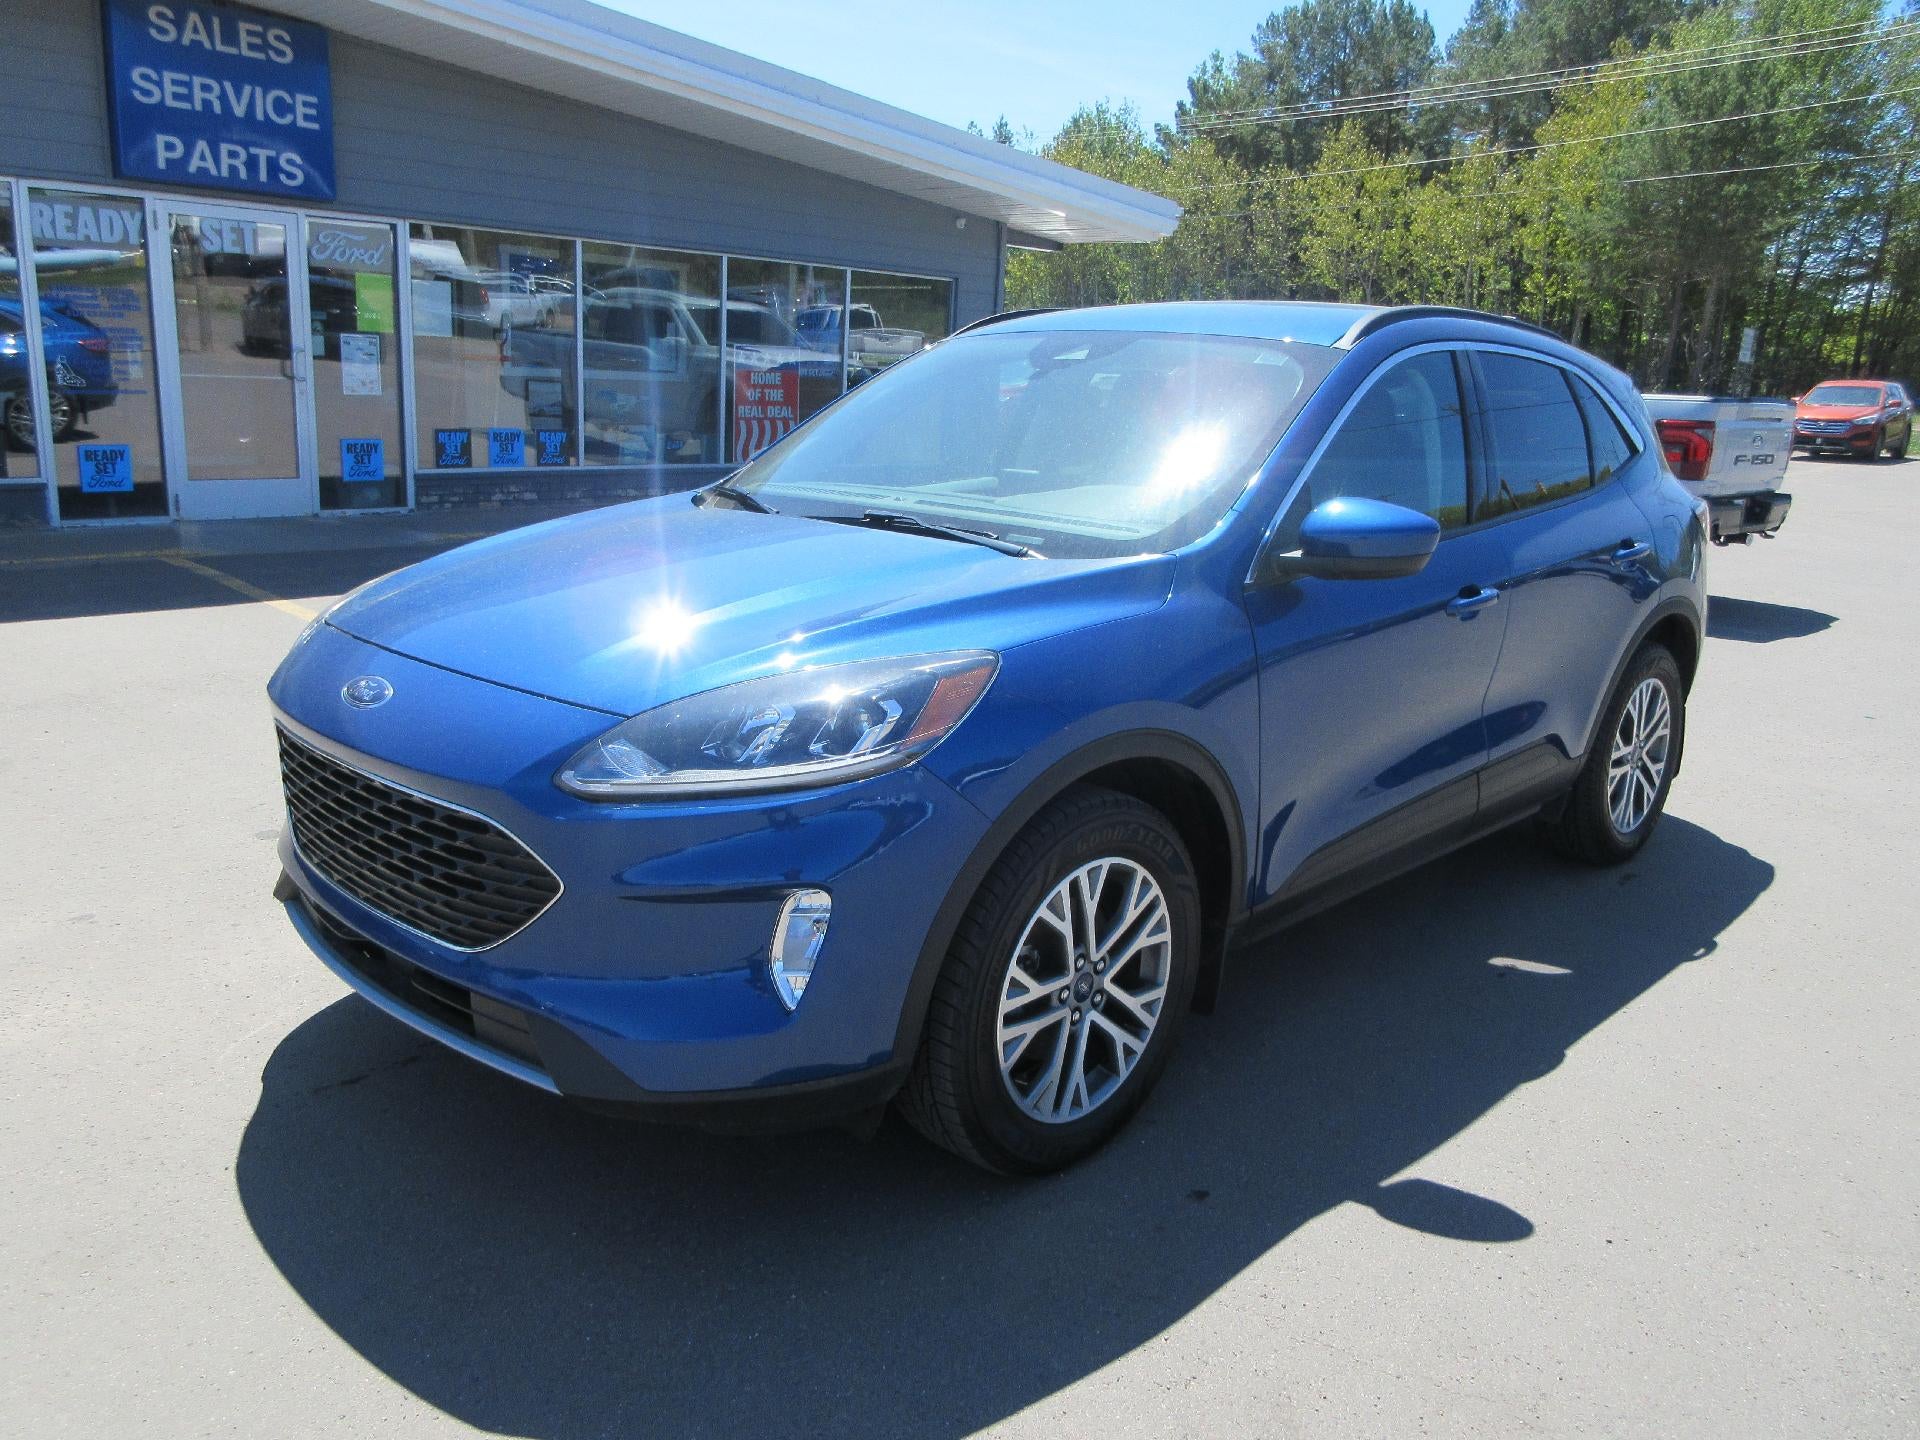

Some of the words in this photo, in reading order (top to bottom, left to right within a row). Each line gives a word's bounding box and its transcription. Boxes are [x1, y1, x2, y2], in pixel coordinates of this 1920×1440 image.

[148, 5, 295, 64] SALES
[131, 67, 320, 131] SERVICE
[155, 134, 305, 187] PARTS
[30, 202, 143, 245] READY
[200, 217, 257, 255] SET
[310, 230, 385, 266] Ford
[750, 371, 782, 385] HOME
[747, 389, 761, 401] OF
[765, 389, 784, 402] THE
[738, 405, 764, 418] REAL
[767, 405, 794, 418] DEAL
[439, 431, 468, 442] READY
[493, 431, 520, 442] READY
[540, 431, 567, 442] READY
[346, 443, 379, 454] READY
[445, 442, 460, 453] SET
[84, 449, 125, 462] READY
[353, 453, 372, 465] SET
[1733, 454, 1775, 466] F-150
[94, 460, 117, 474] SET
[348, 464, 378, 478] Ford
[88, 475, 127, 488] Ford
